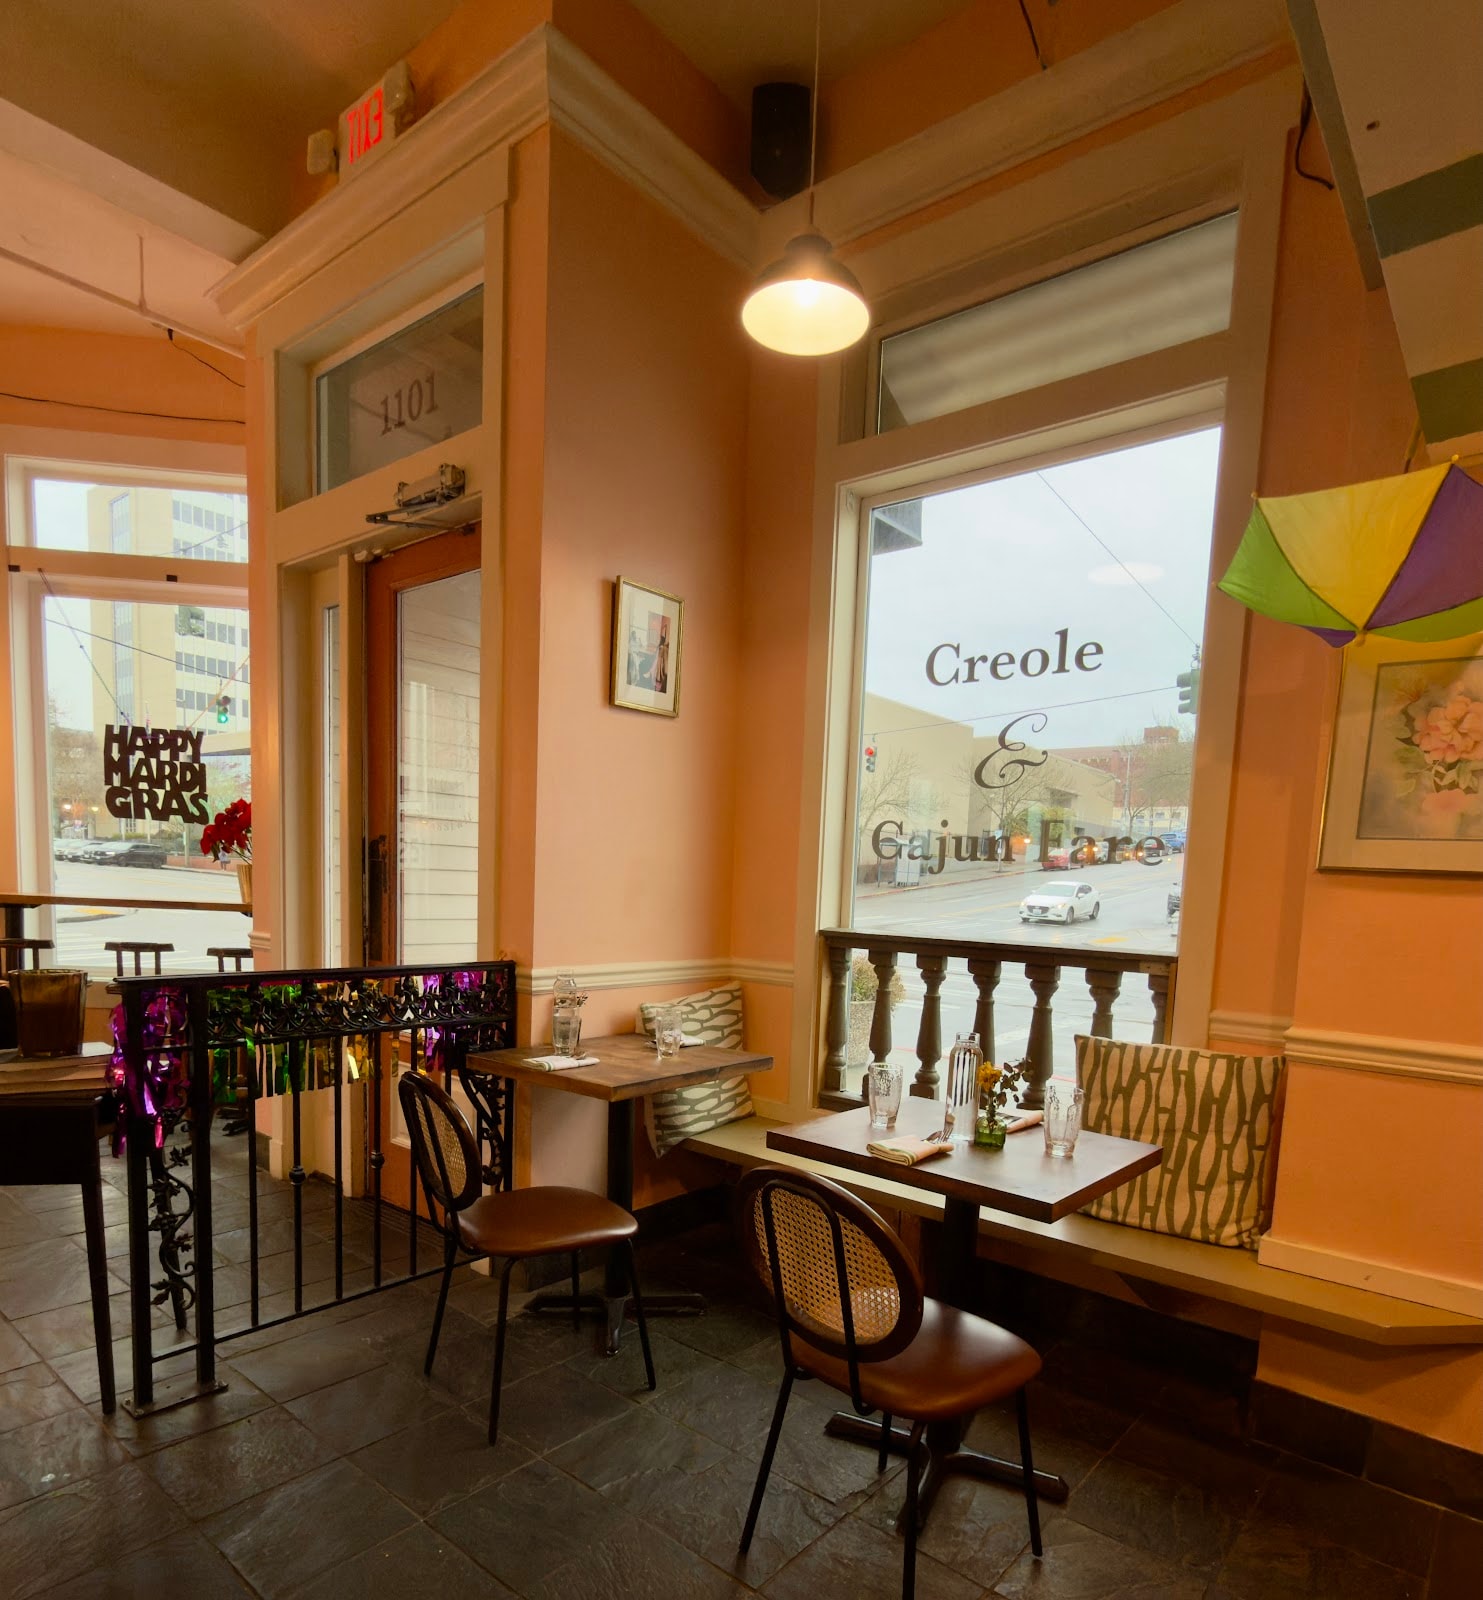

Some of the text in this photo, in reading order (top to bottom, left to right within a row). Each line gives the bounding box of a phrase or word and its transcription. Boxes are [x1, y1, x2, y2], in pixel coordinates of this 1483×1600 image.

[380, 369, 438, 436] 1101
[925, 627, 1104, 687] Creole
[104, 724, 204, 763] HAPPY
[974, 712, 1048, 789] &
[104, 754, 206, 794] MARDI
[105, 785, 209, 826] GRAS
[872, 819, 1166, 875] Cajun Fare
